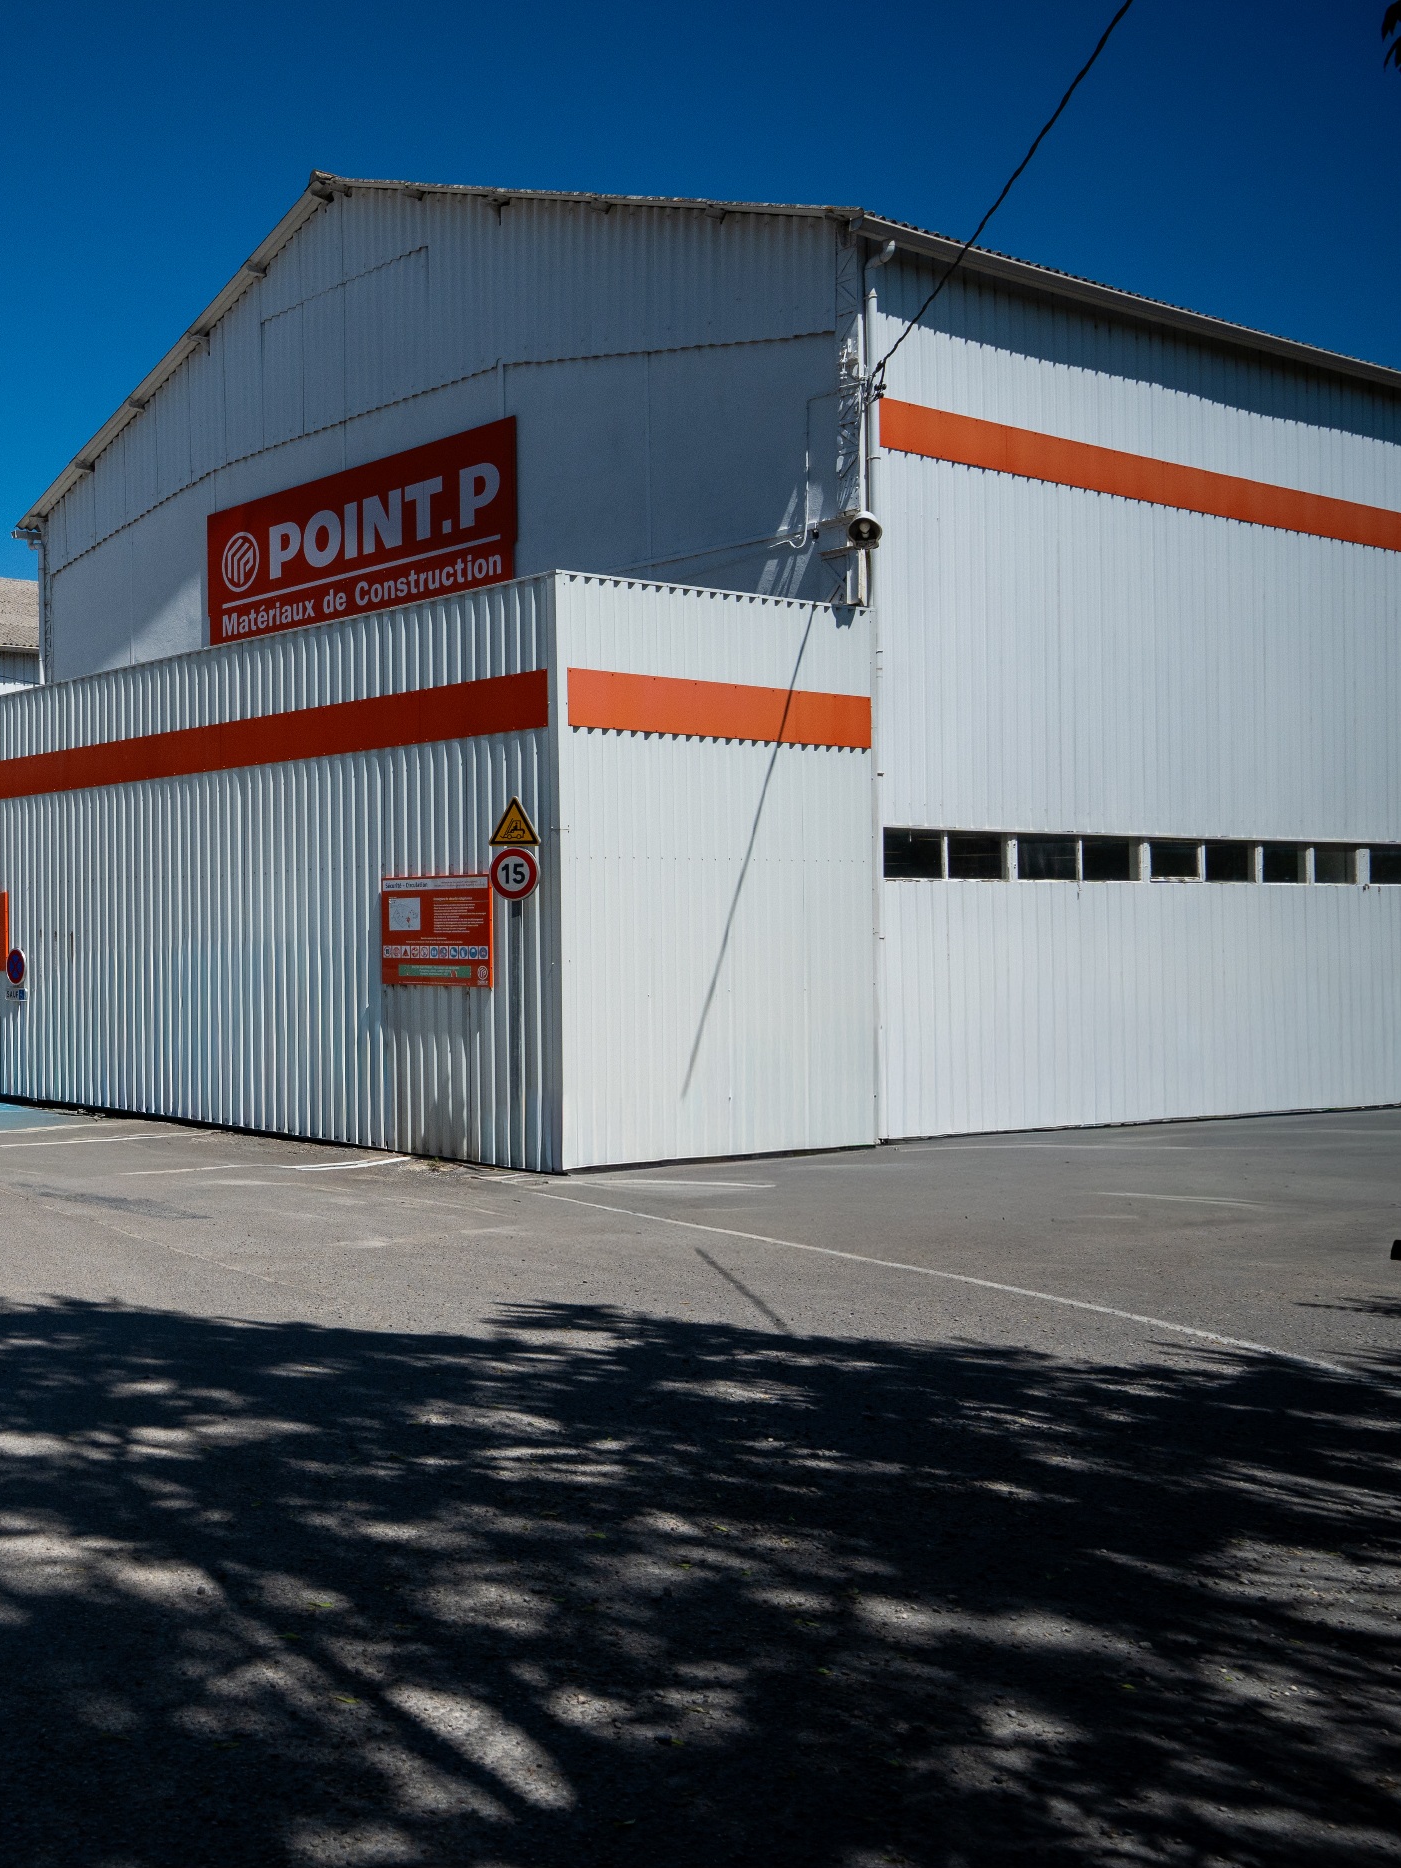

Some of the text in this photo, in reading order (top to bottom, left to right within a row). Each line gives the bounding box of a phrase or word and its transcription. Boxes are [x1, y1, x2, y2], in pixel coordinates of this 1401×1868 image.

[268, 462, 501, 581] POINT.P
[221, 553, 503, 638] Matériaux de Construction
[501, 863, 526, 885] 15
